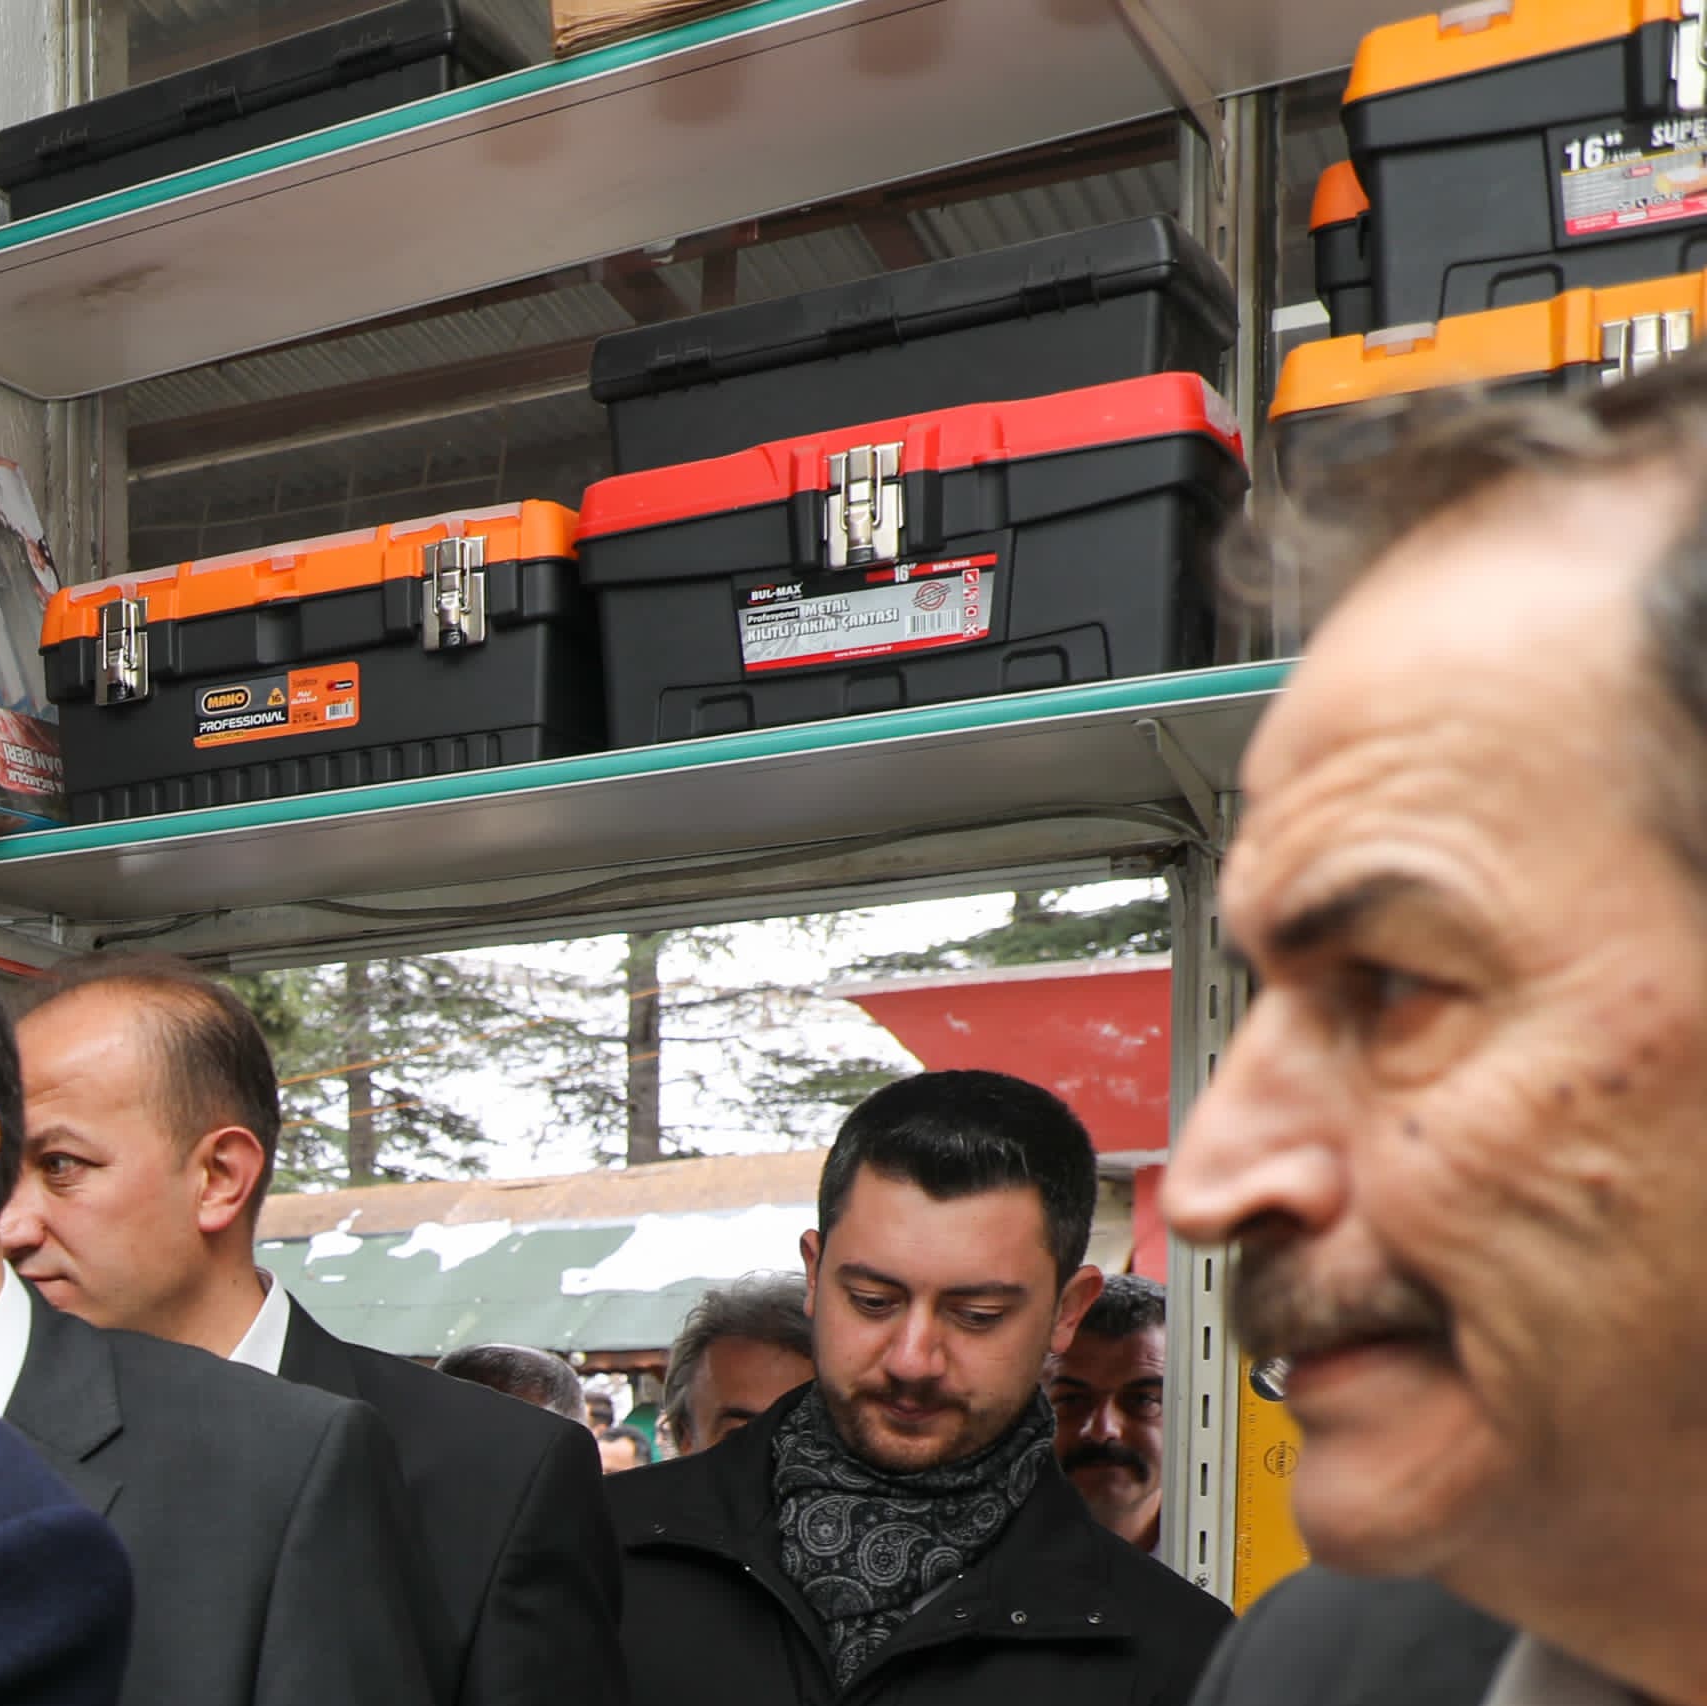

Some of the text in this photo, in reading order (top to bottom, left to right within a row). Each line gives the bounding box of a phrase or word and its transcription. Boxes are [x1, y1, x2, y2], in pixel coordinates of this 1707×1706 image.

[750, 585, 803, 601] BUL-MAX
[747, 600, 851, 625] Profesyonel METAL
[793, 619, 837, 638] TAKIM
[841, 608, 900, 633] ÇANTASI
[207, 692, 246, 710] MANO
[199, 711, 286, 733] PROFESSIONAL
